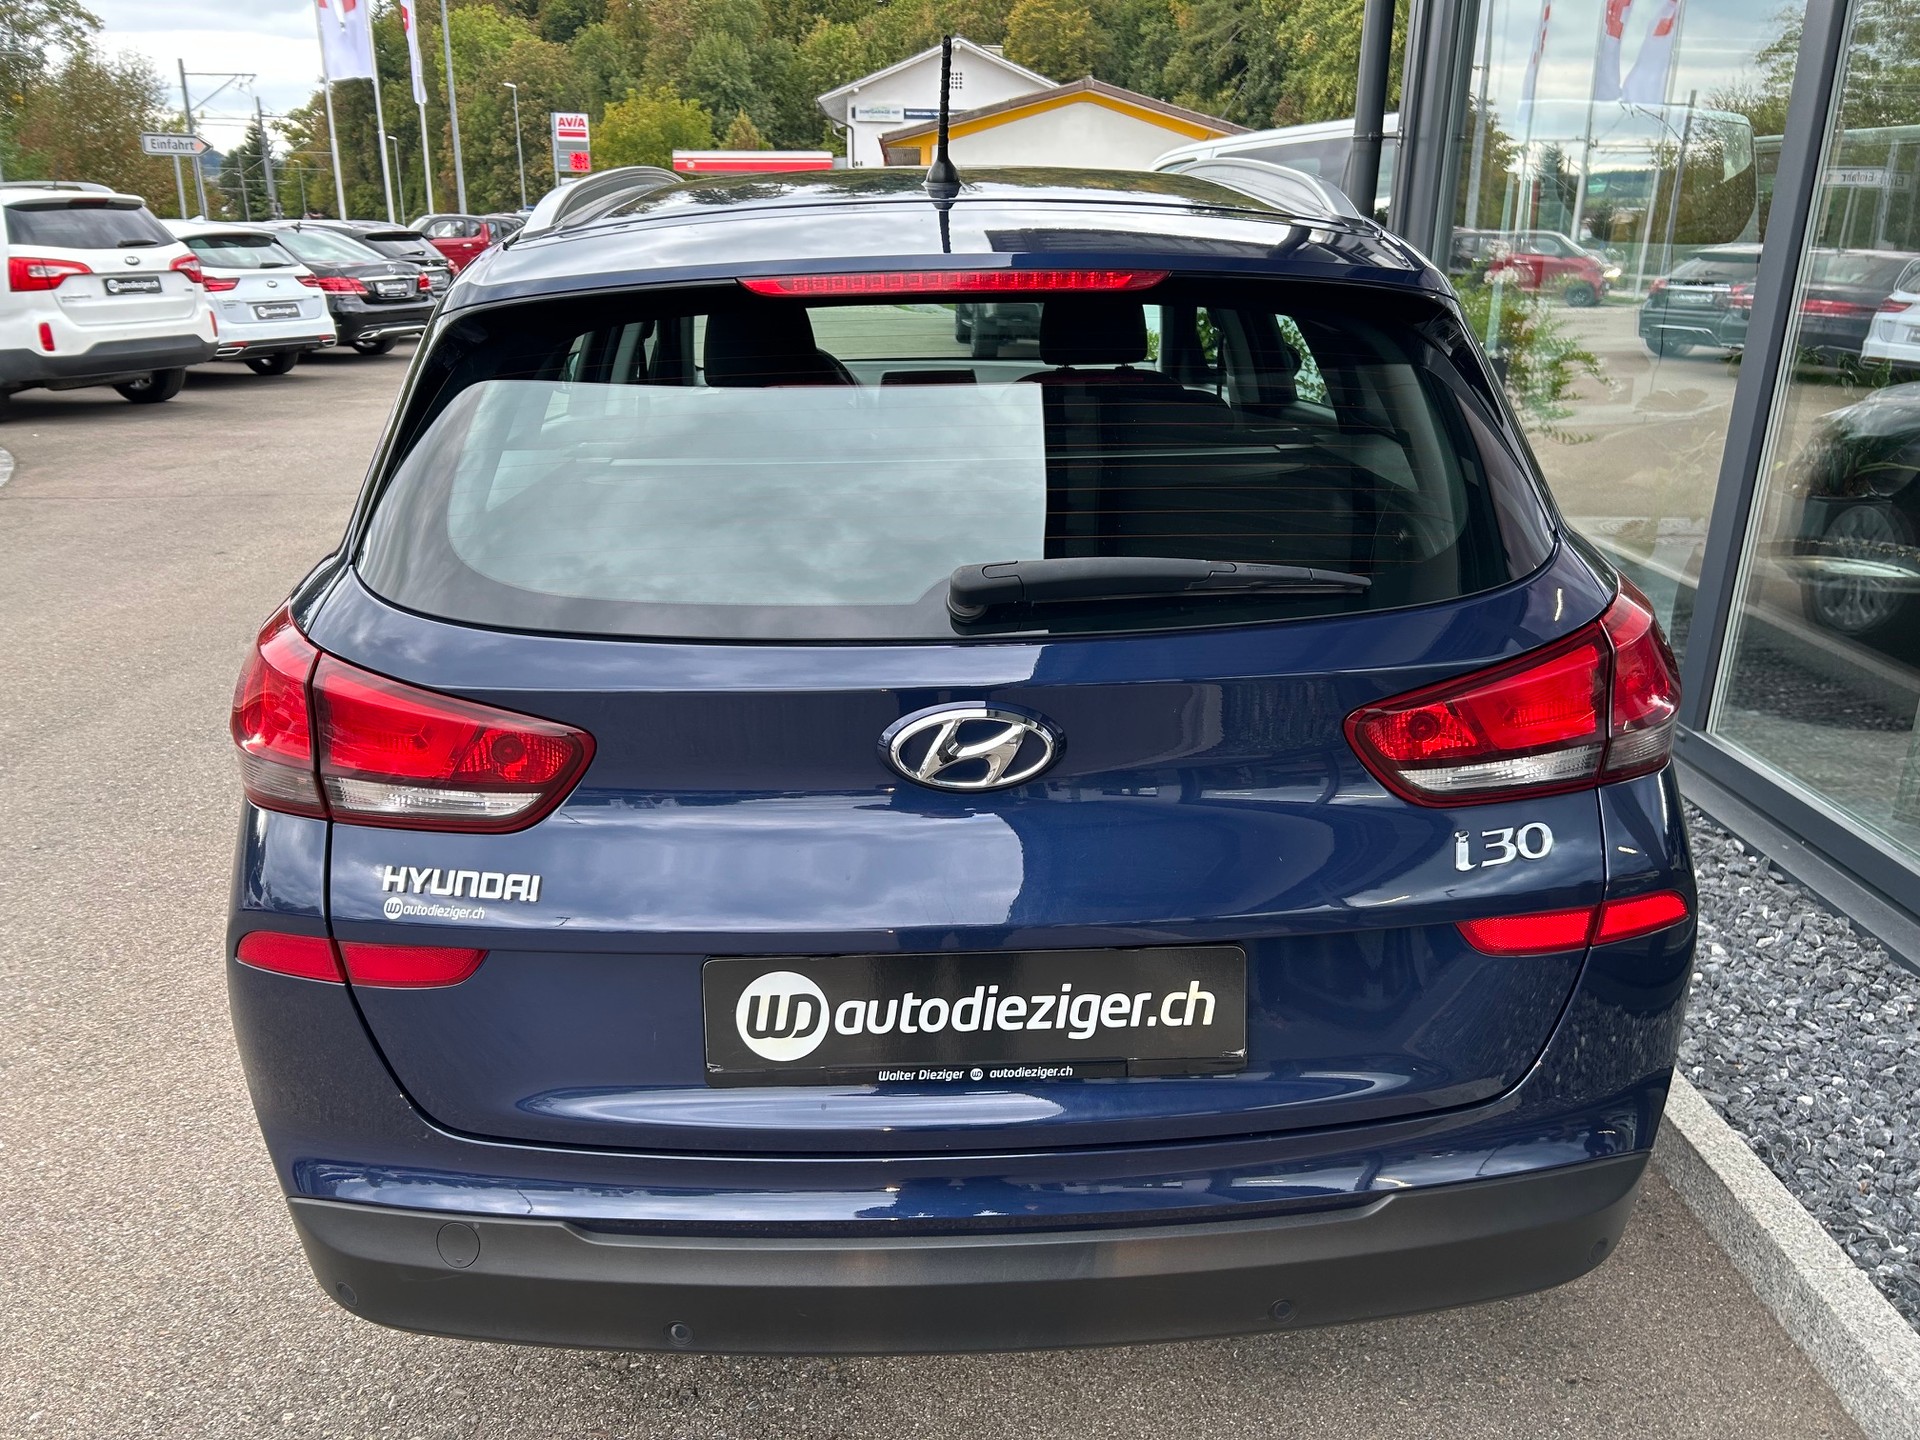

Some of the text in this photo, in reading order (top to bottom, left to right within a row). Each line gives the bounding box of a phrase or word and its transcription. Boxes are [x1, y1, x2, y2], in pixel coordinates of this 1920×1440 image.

[558, 116, 586, 127] AVIA
[150, 138, 195, 150] Einfahrt
[382, 865, 541, 902] HYUNDAI
[403, 903, 485, 921] autodieziger.ch
[834, 980, 1216, 1040] autodieziger.ch
[878, 1069, 916, 1082] Walter
[918, 1069, 964, 1082] Dieziger
[989, 1066, 1073, 1080] autodieziger.ch
